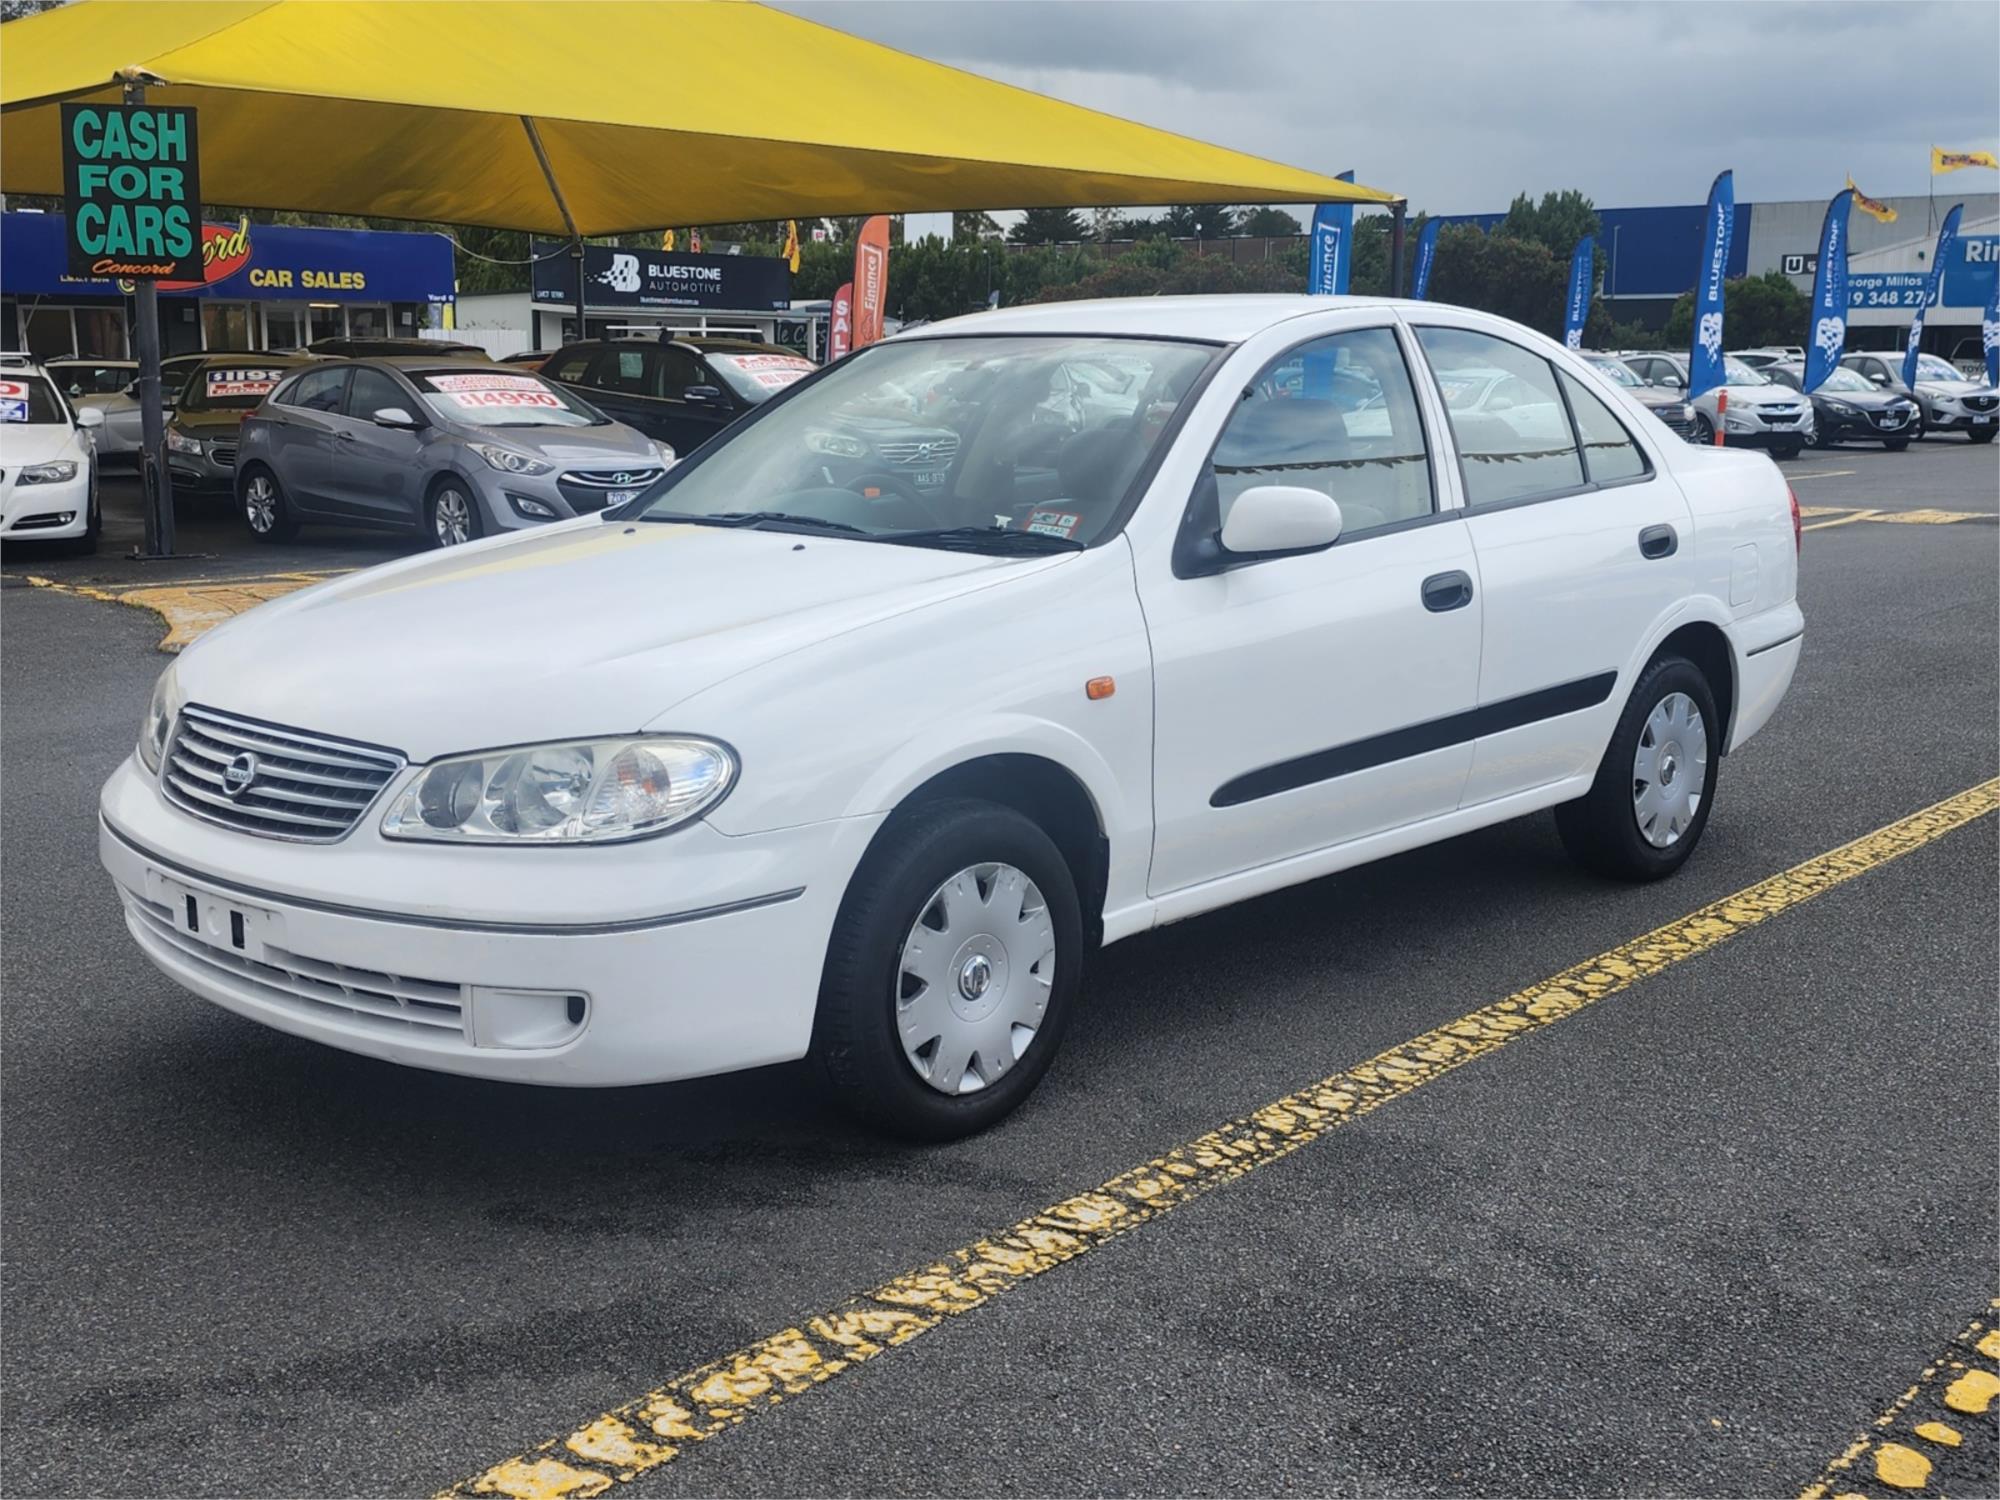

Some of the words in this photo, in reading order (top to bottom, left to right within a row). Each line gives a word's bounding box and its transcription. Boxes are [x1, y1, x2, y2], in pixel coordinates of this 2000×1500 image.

[73, 109, 187, 161] CASH
[78, 164, 185, 200] FOR
[76, 202, 193, 258] CARS
[92, 259, 176, 275] Concord
[648, 264, 721, 280] BLUESTONE
[250, 269, 293, 287] CAR
[301, 270, 365, 289] SALES
[649, 281, 721, 293] AUTOMOTIVE
[864, 255, 878, 311] Finance
[1847, 278, 1883, 289] eorge
[1868, 291, 1898, 305] 348
[1962, 365, 1987, 373] TOYO
[461, 392, 558, 407] $14990
